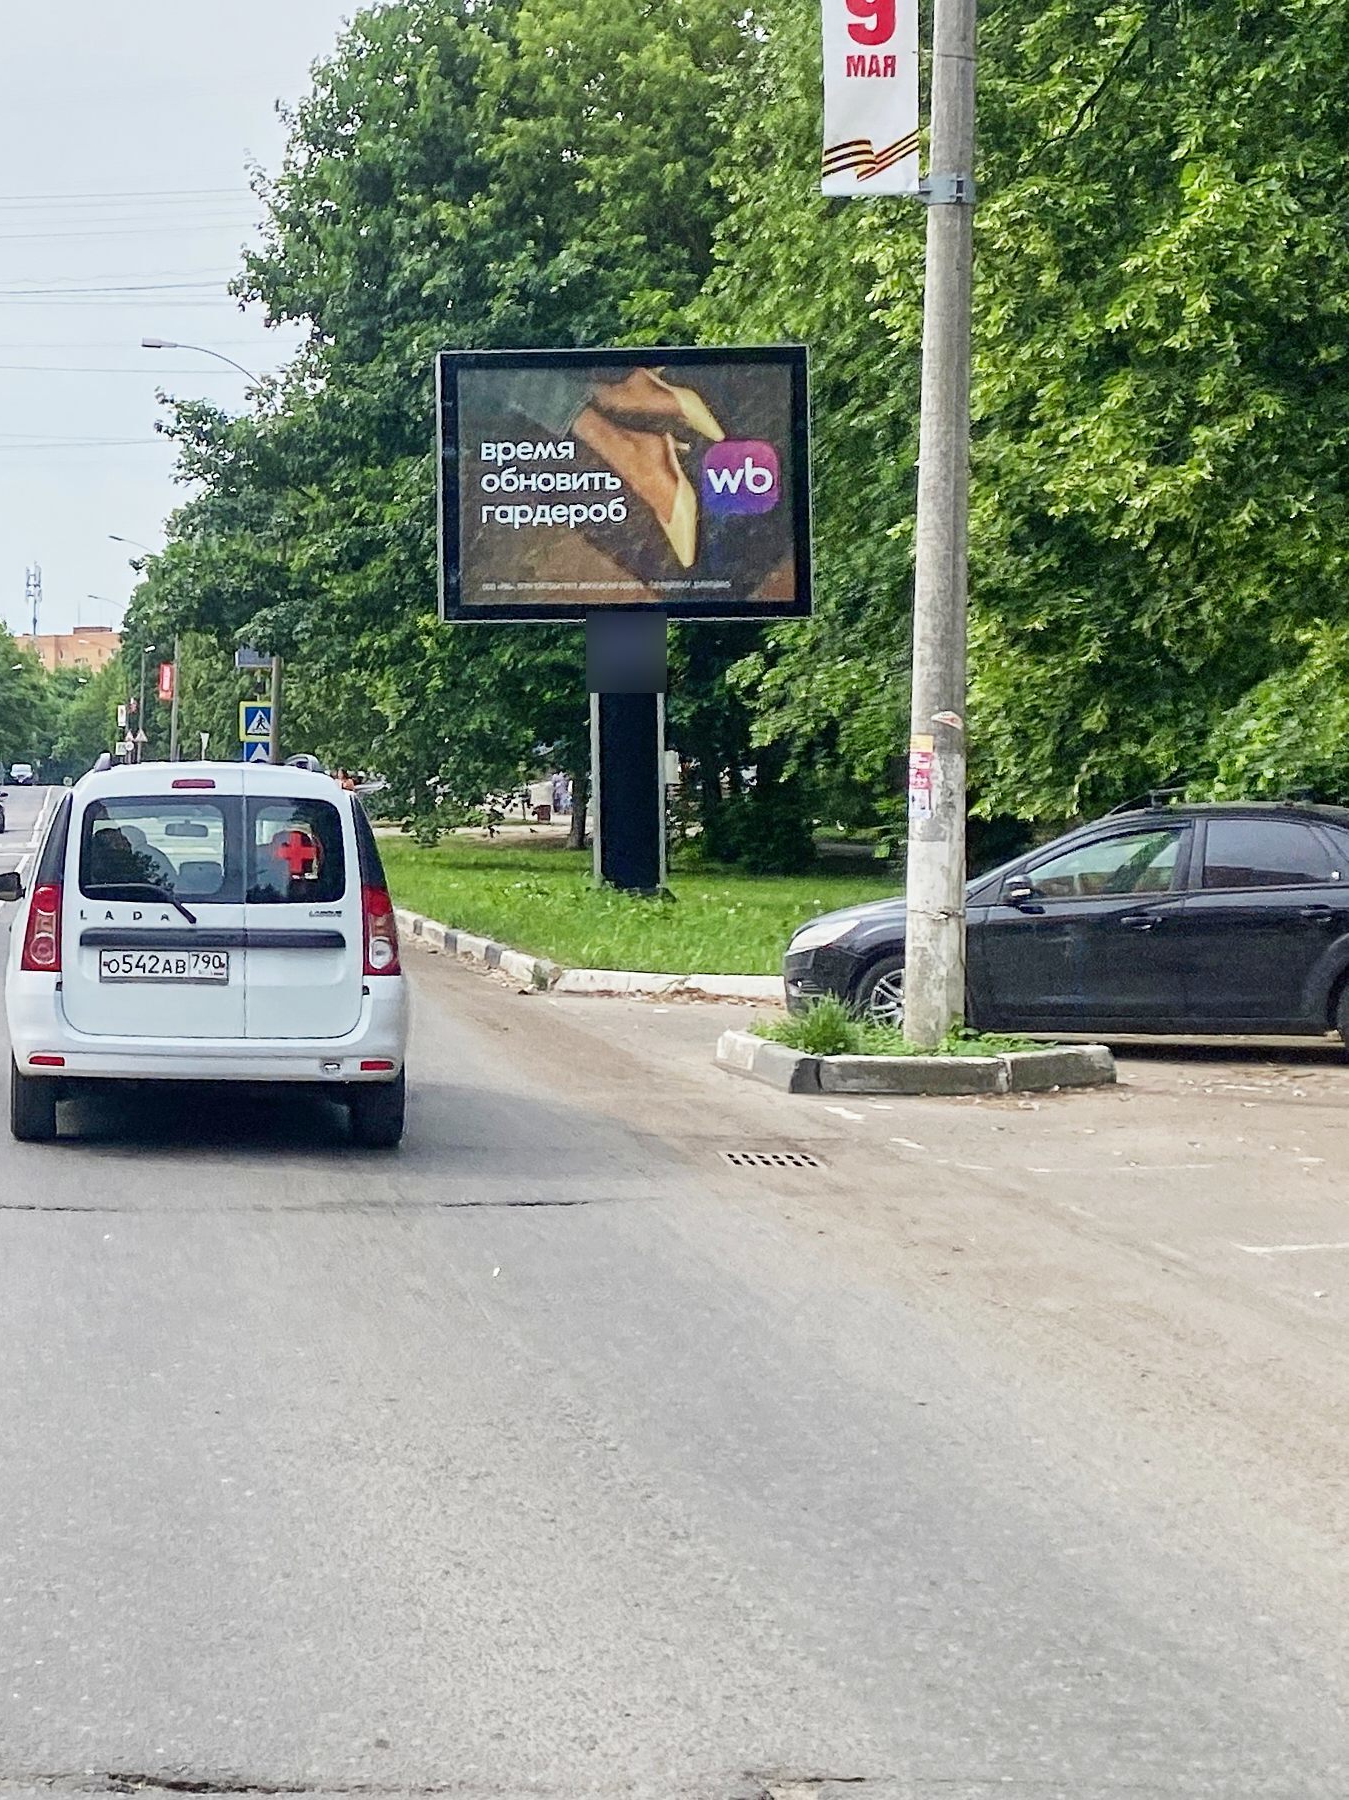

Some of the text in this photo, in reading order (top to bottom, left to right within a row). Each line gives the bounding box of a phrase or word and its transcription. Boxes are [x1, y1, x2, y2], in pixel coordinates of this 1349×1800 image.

[846, 0, 896, 46] 9
[846, 54, 897, 78] МАЯ
[480, 441, 575, 467] время
[480, 466, 622, 493] обновить
[707, 456, 774, 494] wb
[481, 497, 627, 529] гардероб
[79, 909, 170, 921] LADA
[108, 954, 222, 974] О542АВ 790
